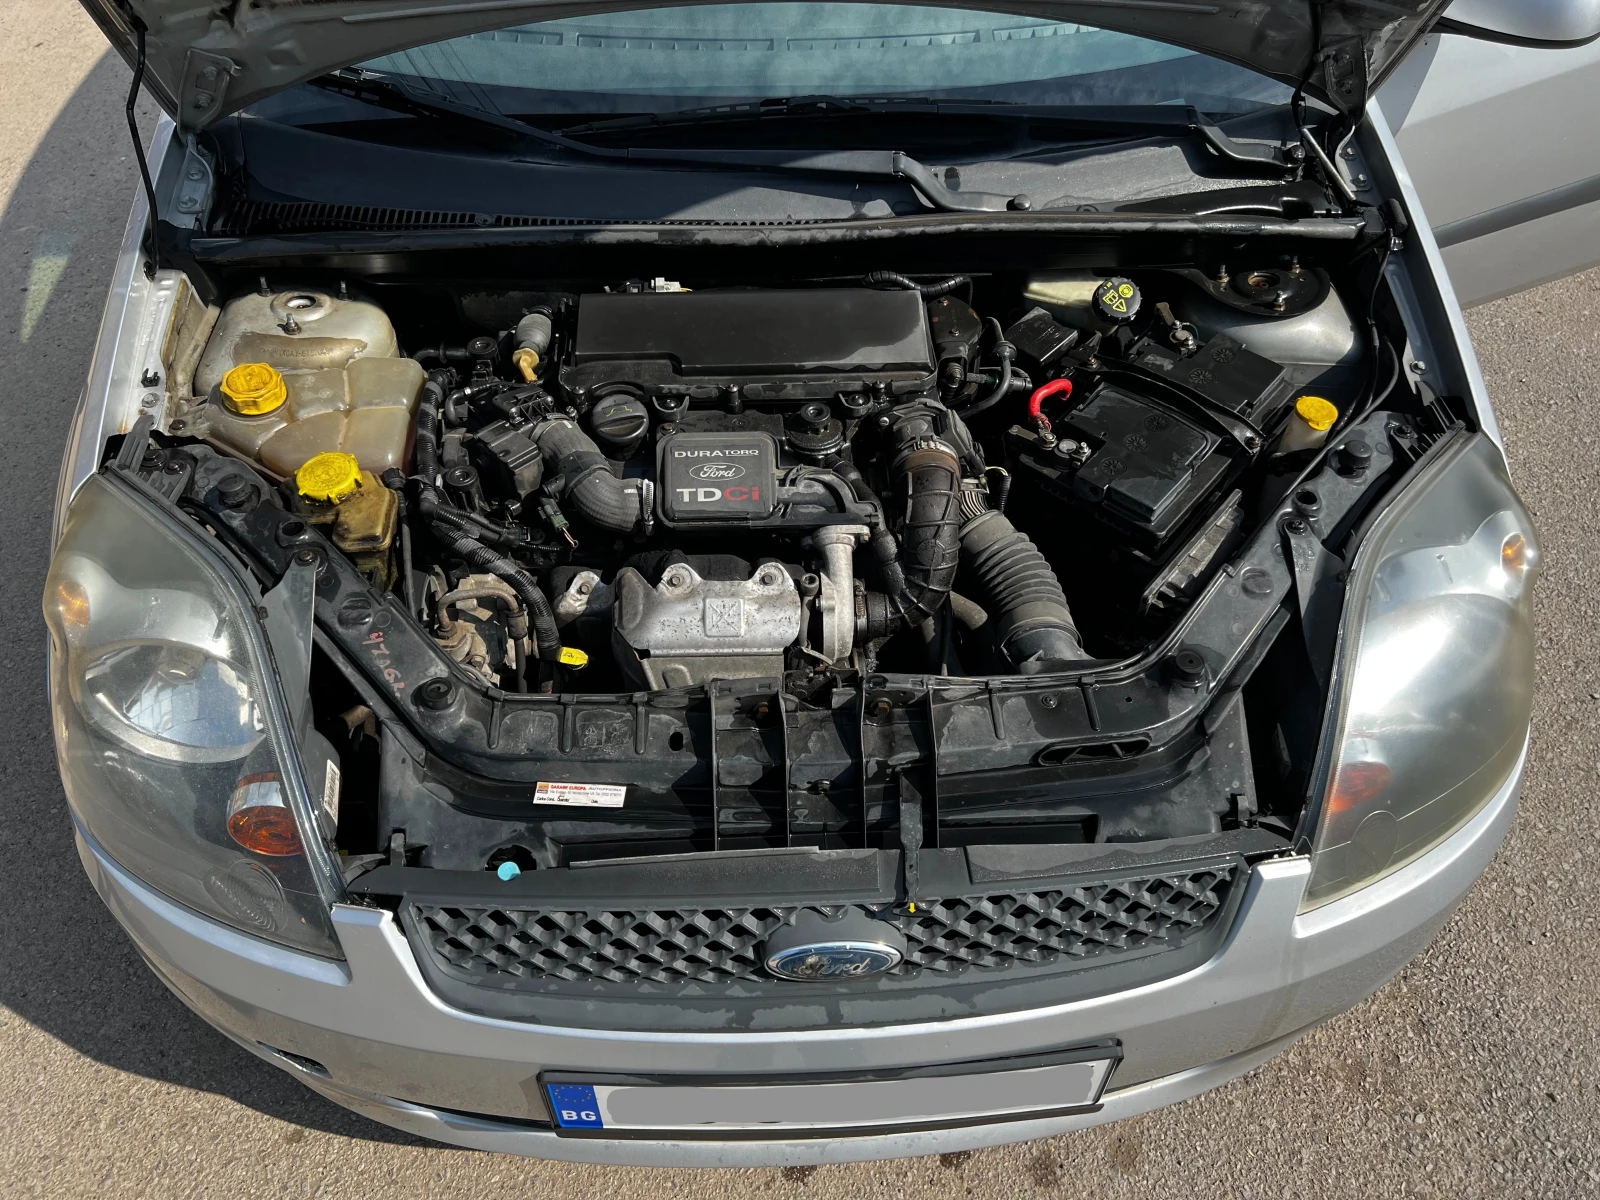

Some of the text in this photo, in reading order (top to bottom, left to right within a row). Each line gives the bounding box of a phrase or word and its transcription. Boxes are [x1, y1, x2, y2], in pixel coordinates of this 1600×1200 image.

[674, 449, 759, 458] DURATORQ
[699, 465, 735, 478] Ford
[676, 487, 760, 502] TDCi
[561, 1110, 597, 1121] BG
